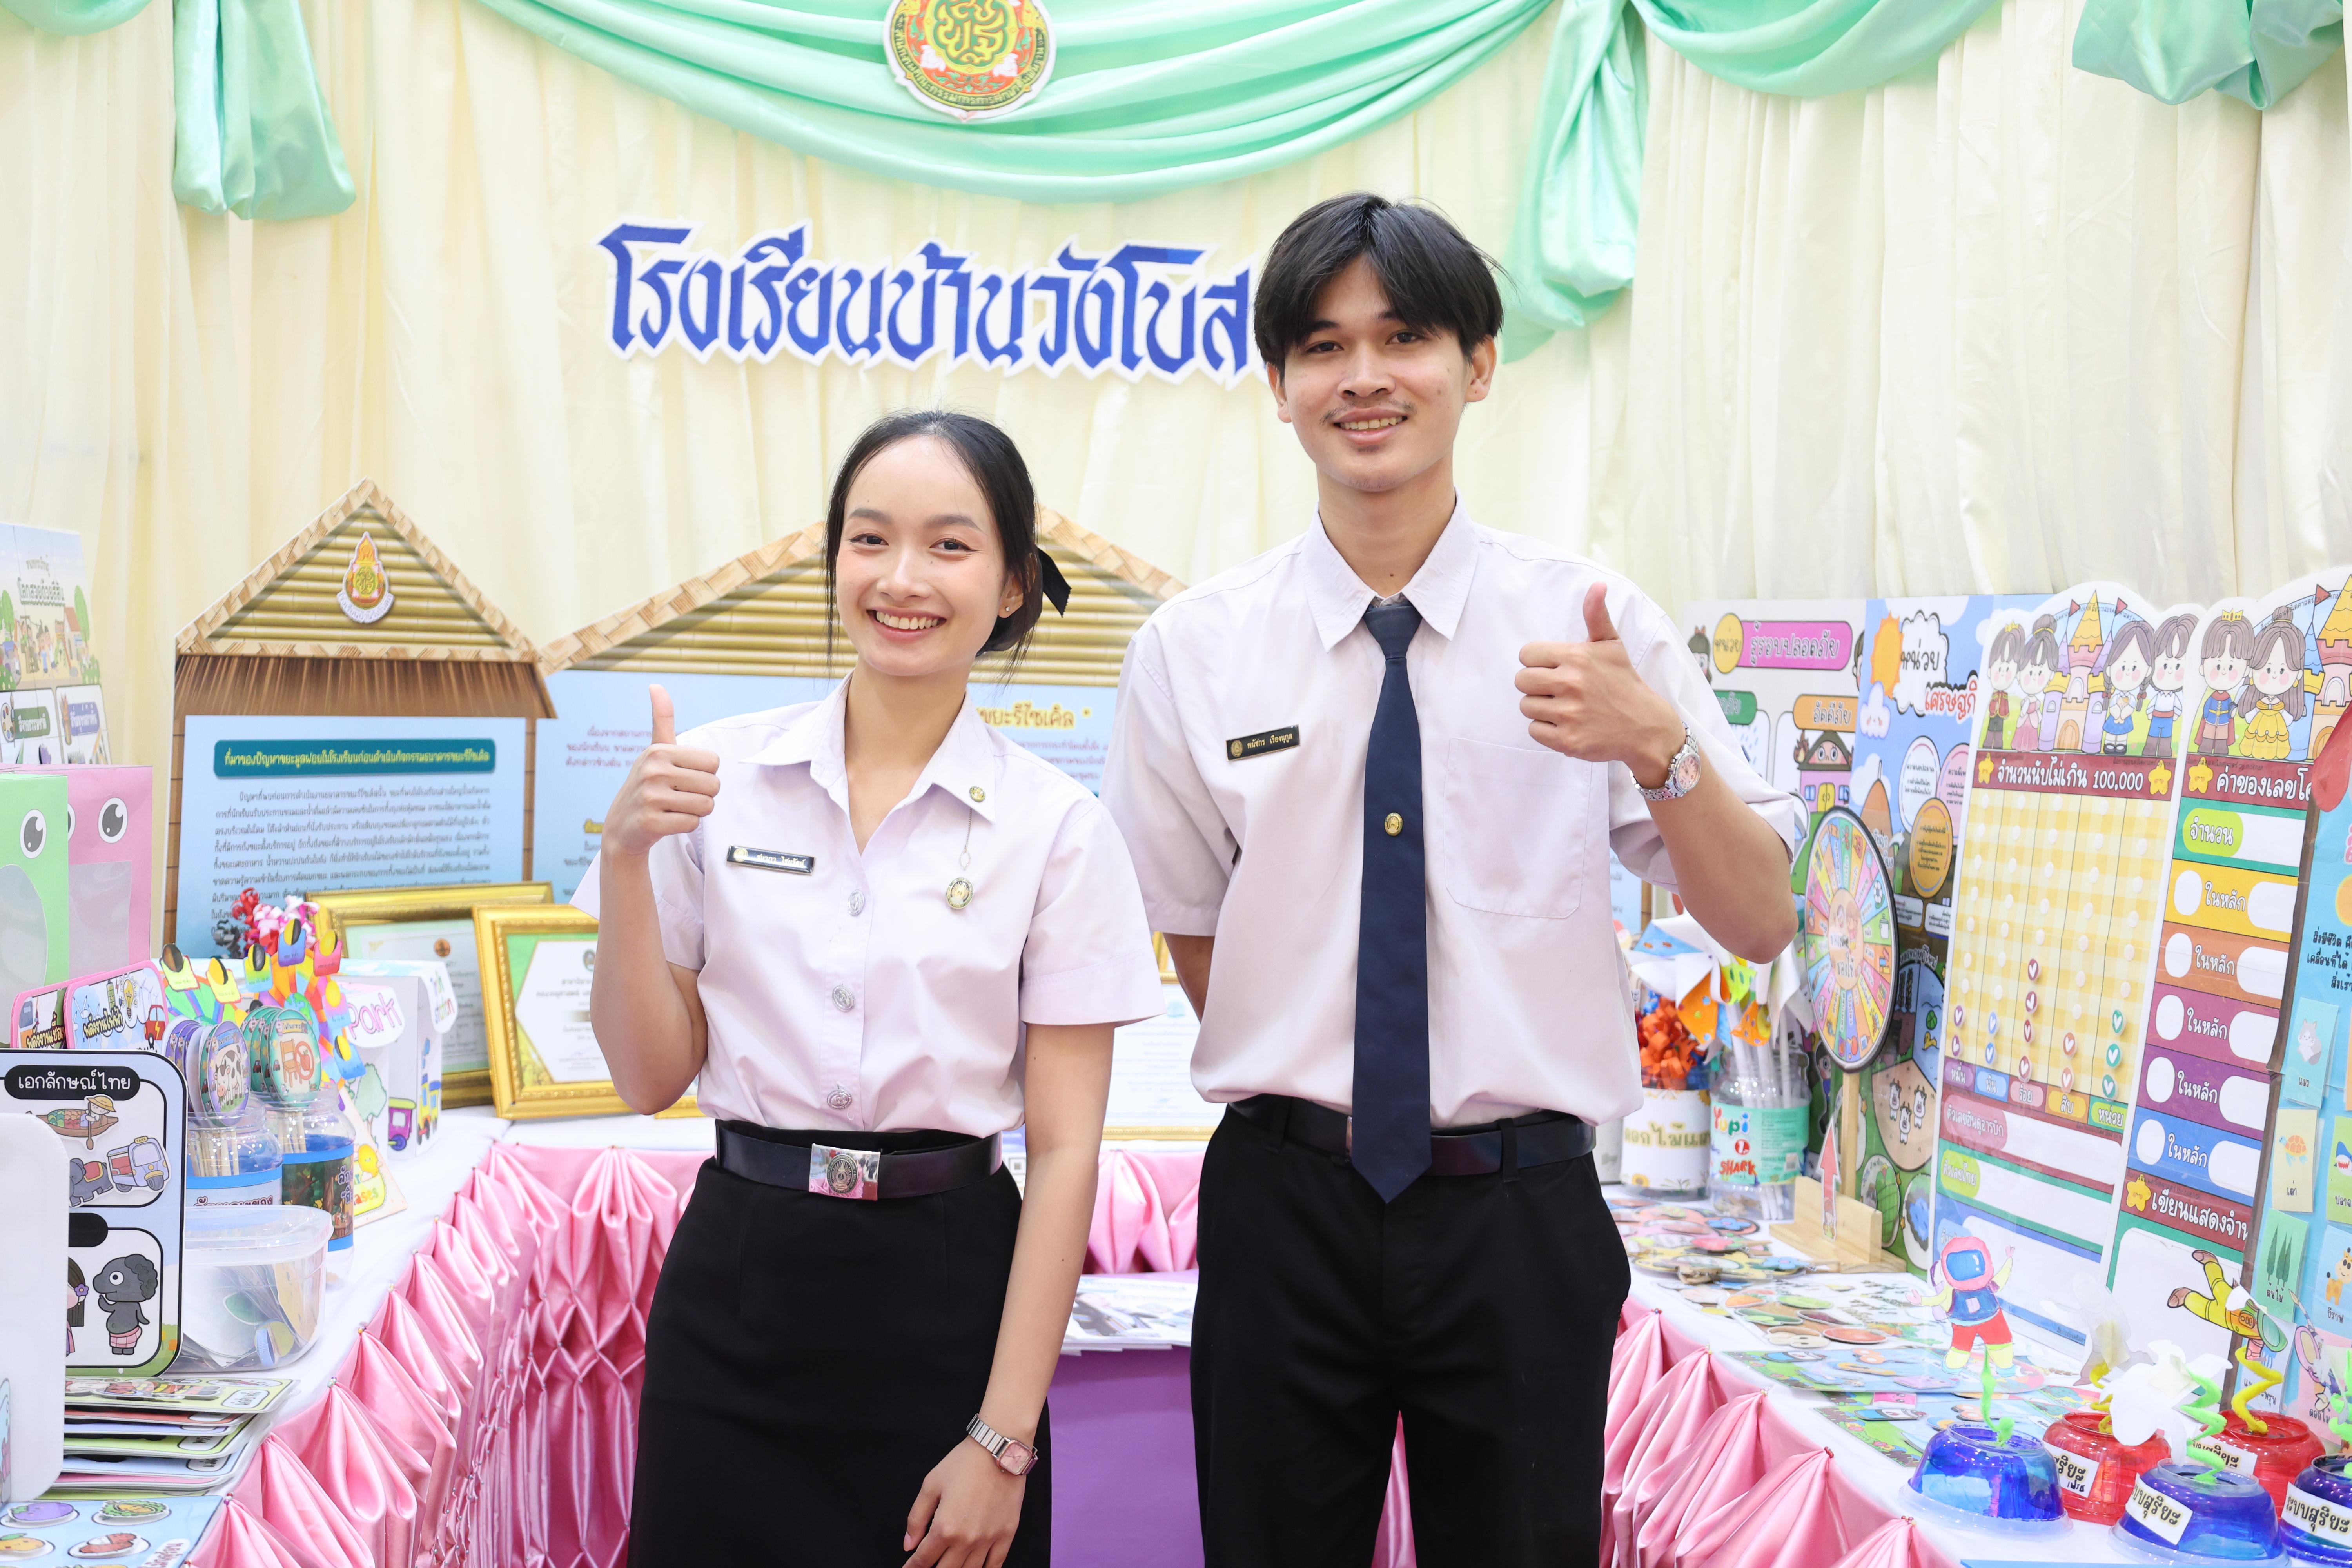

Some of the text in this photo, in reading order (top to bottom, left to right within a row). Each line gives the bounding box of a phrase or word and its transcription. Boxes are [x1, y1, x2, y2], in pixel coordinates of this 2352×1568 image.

[599, 223, 1250, 374] โรงเรียนบ้านวังโบส
[1902, 637, 1941, 671] หน่วย
[1925, 679, 1978, 720] เศรษฐกิ
[1998, 756, 2087, 788] จำนวนนับไม่เกิน
[2093, 770, 2144, 791] 100,000
[2190, 816, 2234, 845] จำนวน
[2205, 881, 2246, 912] ในหลัก
[2195, 944, 2235, 976] ในหลัก
[26, 1012, 65, 1048] พลังงานเชื้อ
[83, 1007, 123, 1040] พลังงานไฟฟ้า
[2187, 1007, 2228, 1041] ในหลัก
[18, 1069, 131, 1091] เอกลักษณ์ไทย
[1985, 1074, 1997, 1094] พัน
[2019, 1087, 2033, 1103] ร้อย
[2177, 1070, 2218, 1105] ในหลัก
[2298, 1077, 2310, 1088] แมว
[2060, 1095, 2074, 1114] สิบ
[2098, 1102, 2124, 1127] หน่วย
[1713, 1105, 1749, 1136] Yupi
[1947, 1103, 2004, 1138] ตัวเลขฮินดูอารบิก
[2168, 1132, 2207, 1168] ในหลัก
[1943, 1158, 1976, 1186] ตัวเลขไทย
[354, 1185, 379, 1204] ases
[2287, 1180, 2298, 1196] เต่า
[2335, 1194, 2352, 1207] ปลาฉ
[2267, 1282, 2285, 1303] ต้นไม้
[2327, 1307, 2344, 1324] ยีราฟ
[2286, 1495, 2350, 1533] ระบบสุริยะ
